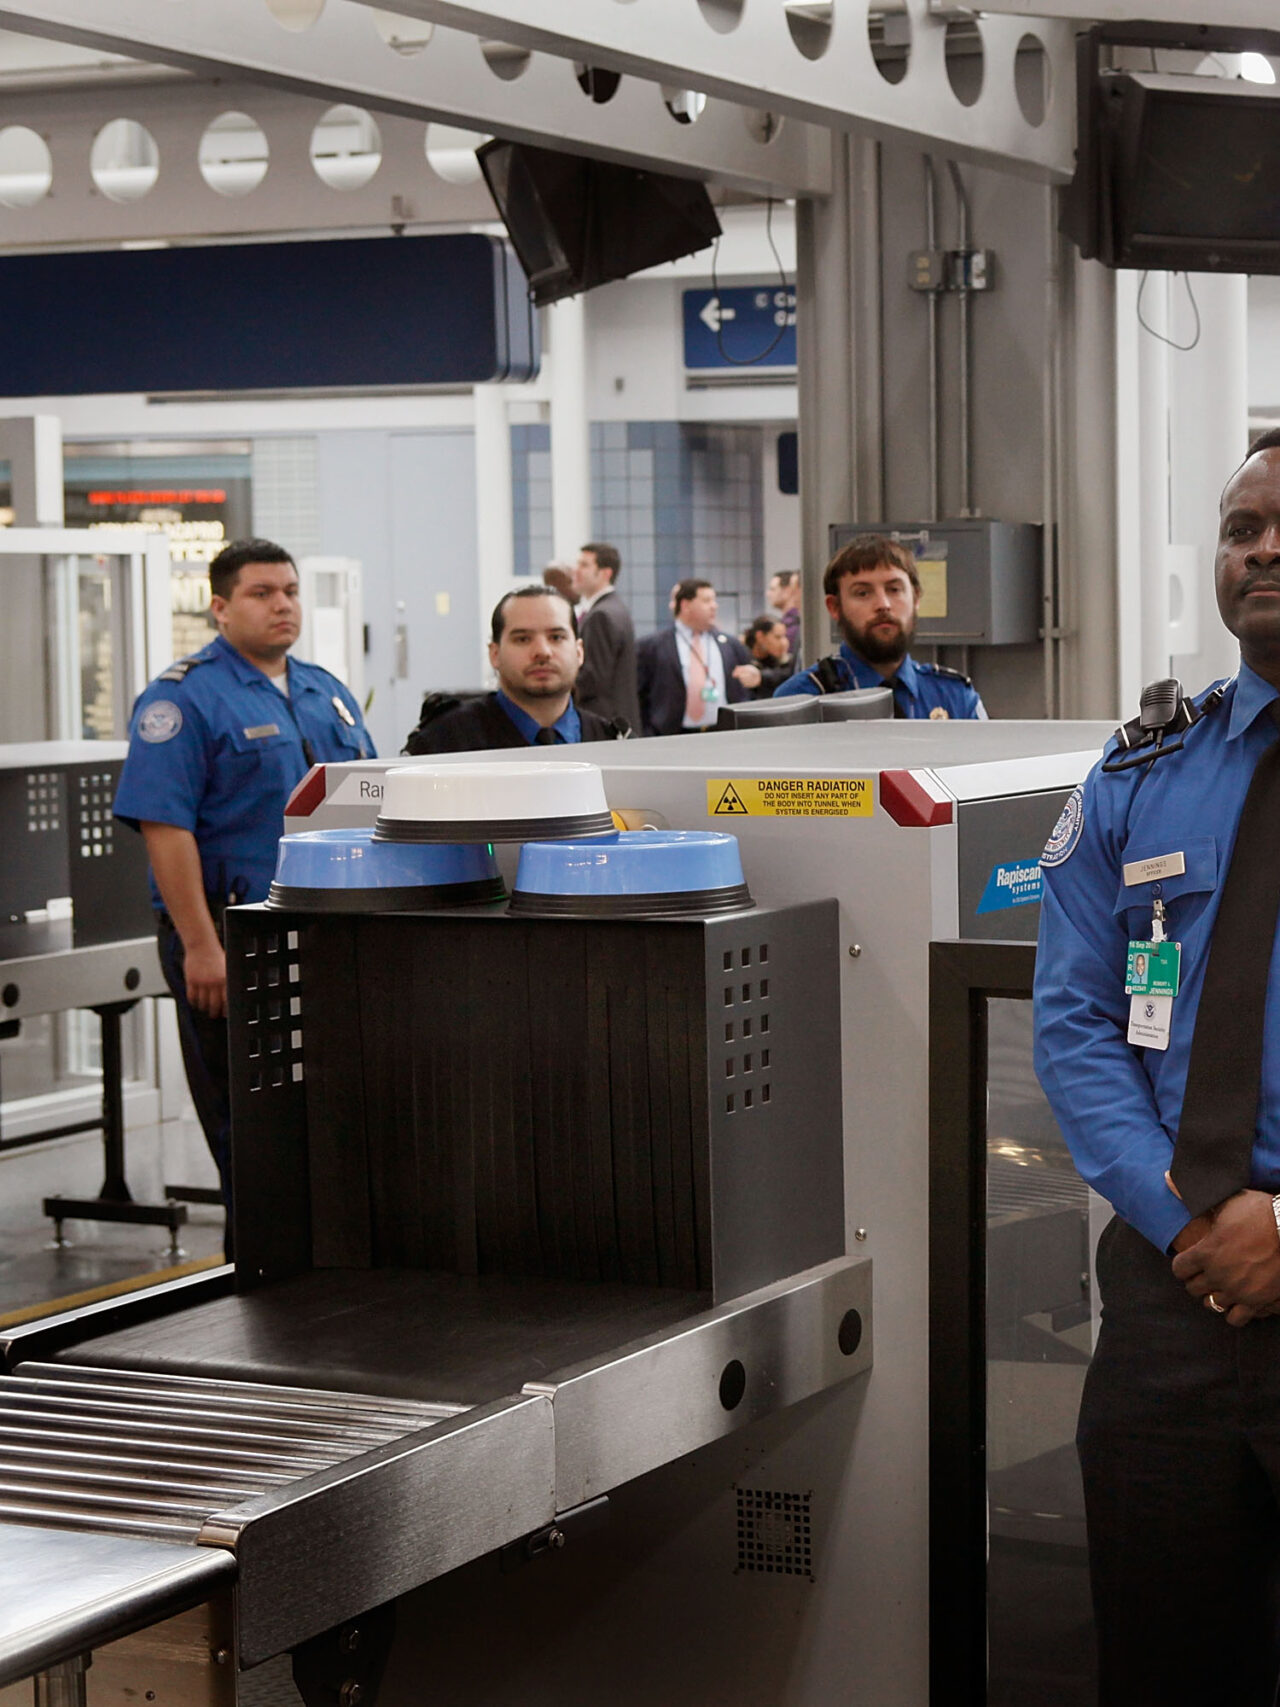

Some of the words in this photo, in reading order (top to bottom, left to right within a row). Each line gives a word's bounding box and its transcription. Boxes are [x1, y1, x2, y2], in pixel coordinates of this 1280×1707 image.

[758, 780, 804, 792] DANGER
[806, 780, 865, 792] RADIATION
[763, 800, 776, 808] THE
[777, 800, 796, 808] BODY
[796, 800, 813, 808] INTO
[813, 800, 840, 808] TUNNEL
[841, 800, 861, 808] WHEN
[775, 808, 802, 816] SYSTEM
[802, 808, 810, 816] IS
[810, 808, 849, 816] ENERGISED
[1140, 860, 1167, 873] JENNINGS
[996, 864, 1042, 890] Rapiscan
[1011, 881, 1041, 895] systems
[1149, 987, 1173, 995] JENNINGS
